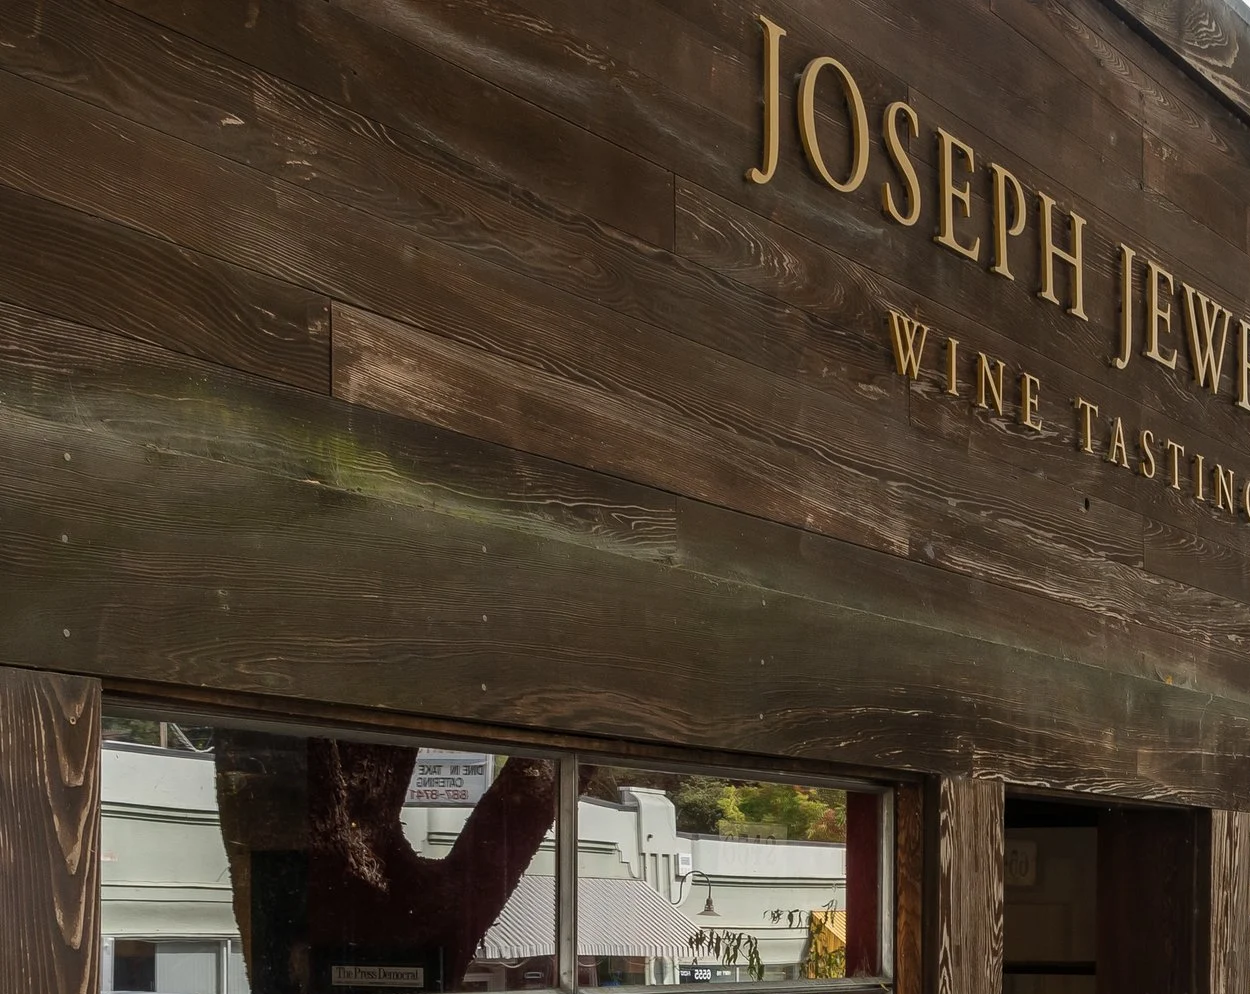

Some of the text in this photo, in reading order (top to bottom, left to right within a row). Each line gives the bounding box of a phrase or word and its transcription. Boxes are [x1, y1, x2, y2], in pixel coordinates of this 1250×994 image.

[745, 15, 1088, 321] JOSEPH
[888, 309, 1042, 431] WINE
[336, 967, 418, 981] The Press Democrat
